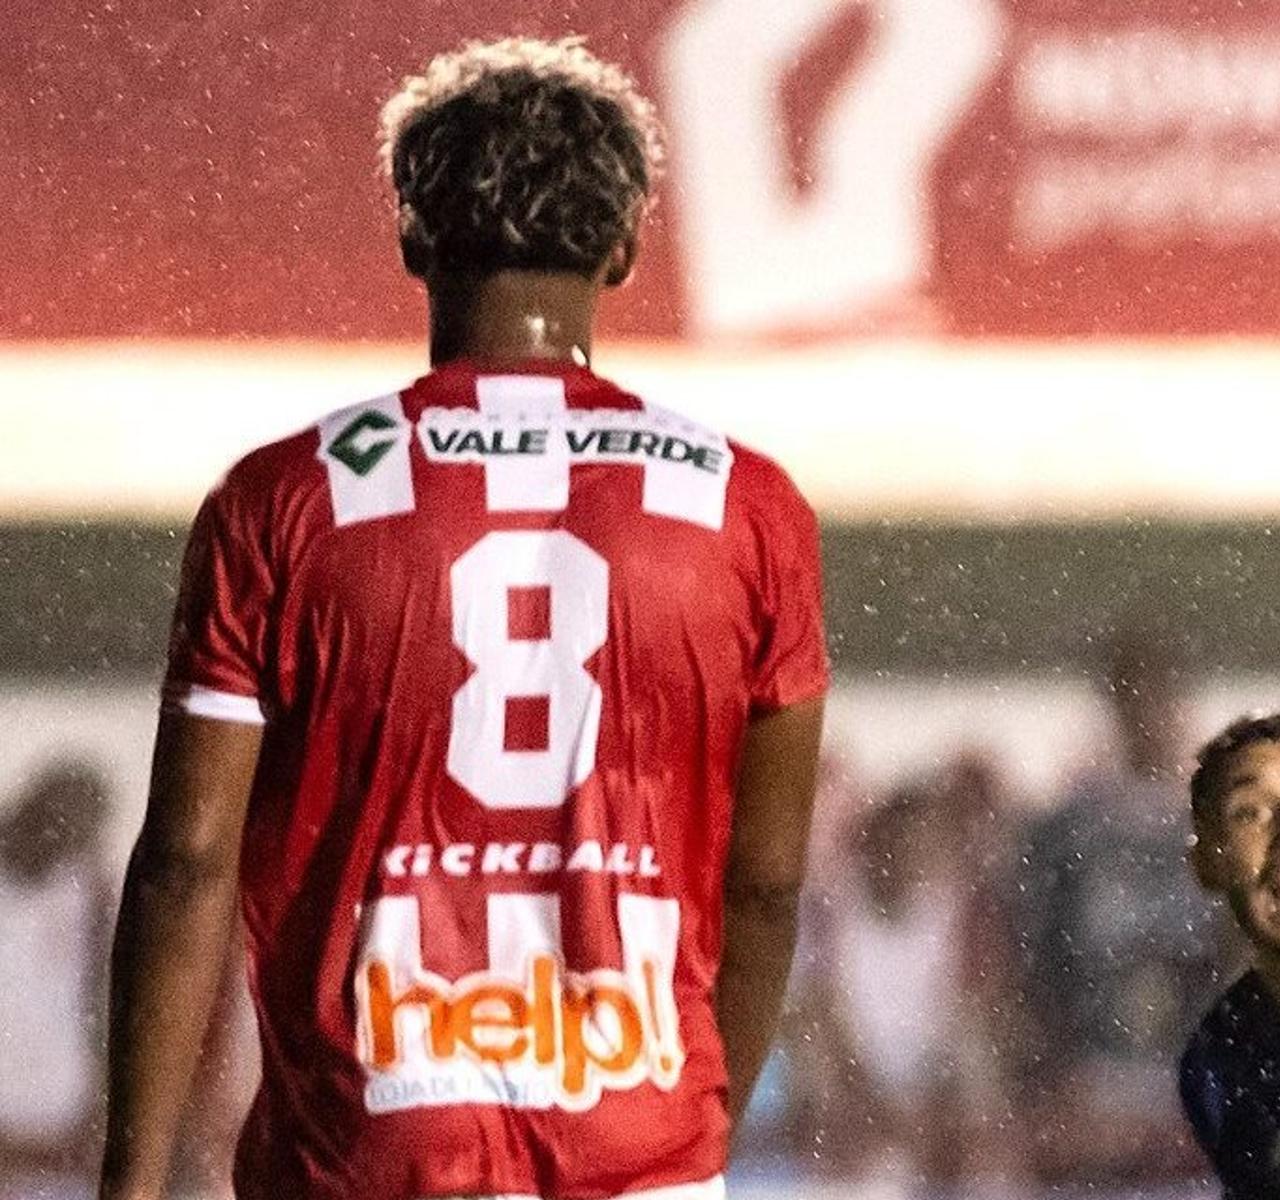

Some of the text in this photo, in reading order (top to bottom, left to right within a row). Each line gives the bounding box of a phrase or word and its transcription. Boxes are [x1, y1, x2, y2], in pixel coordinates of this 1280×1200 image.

[428, 428, 724, 475] VALE VERDE
[446, 529, 610, 809] 8
[365, 954, 674, 1094] help!
